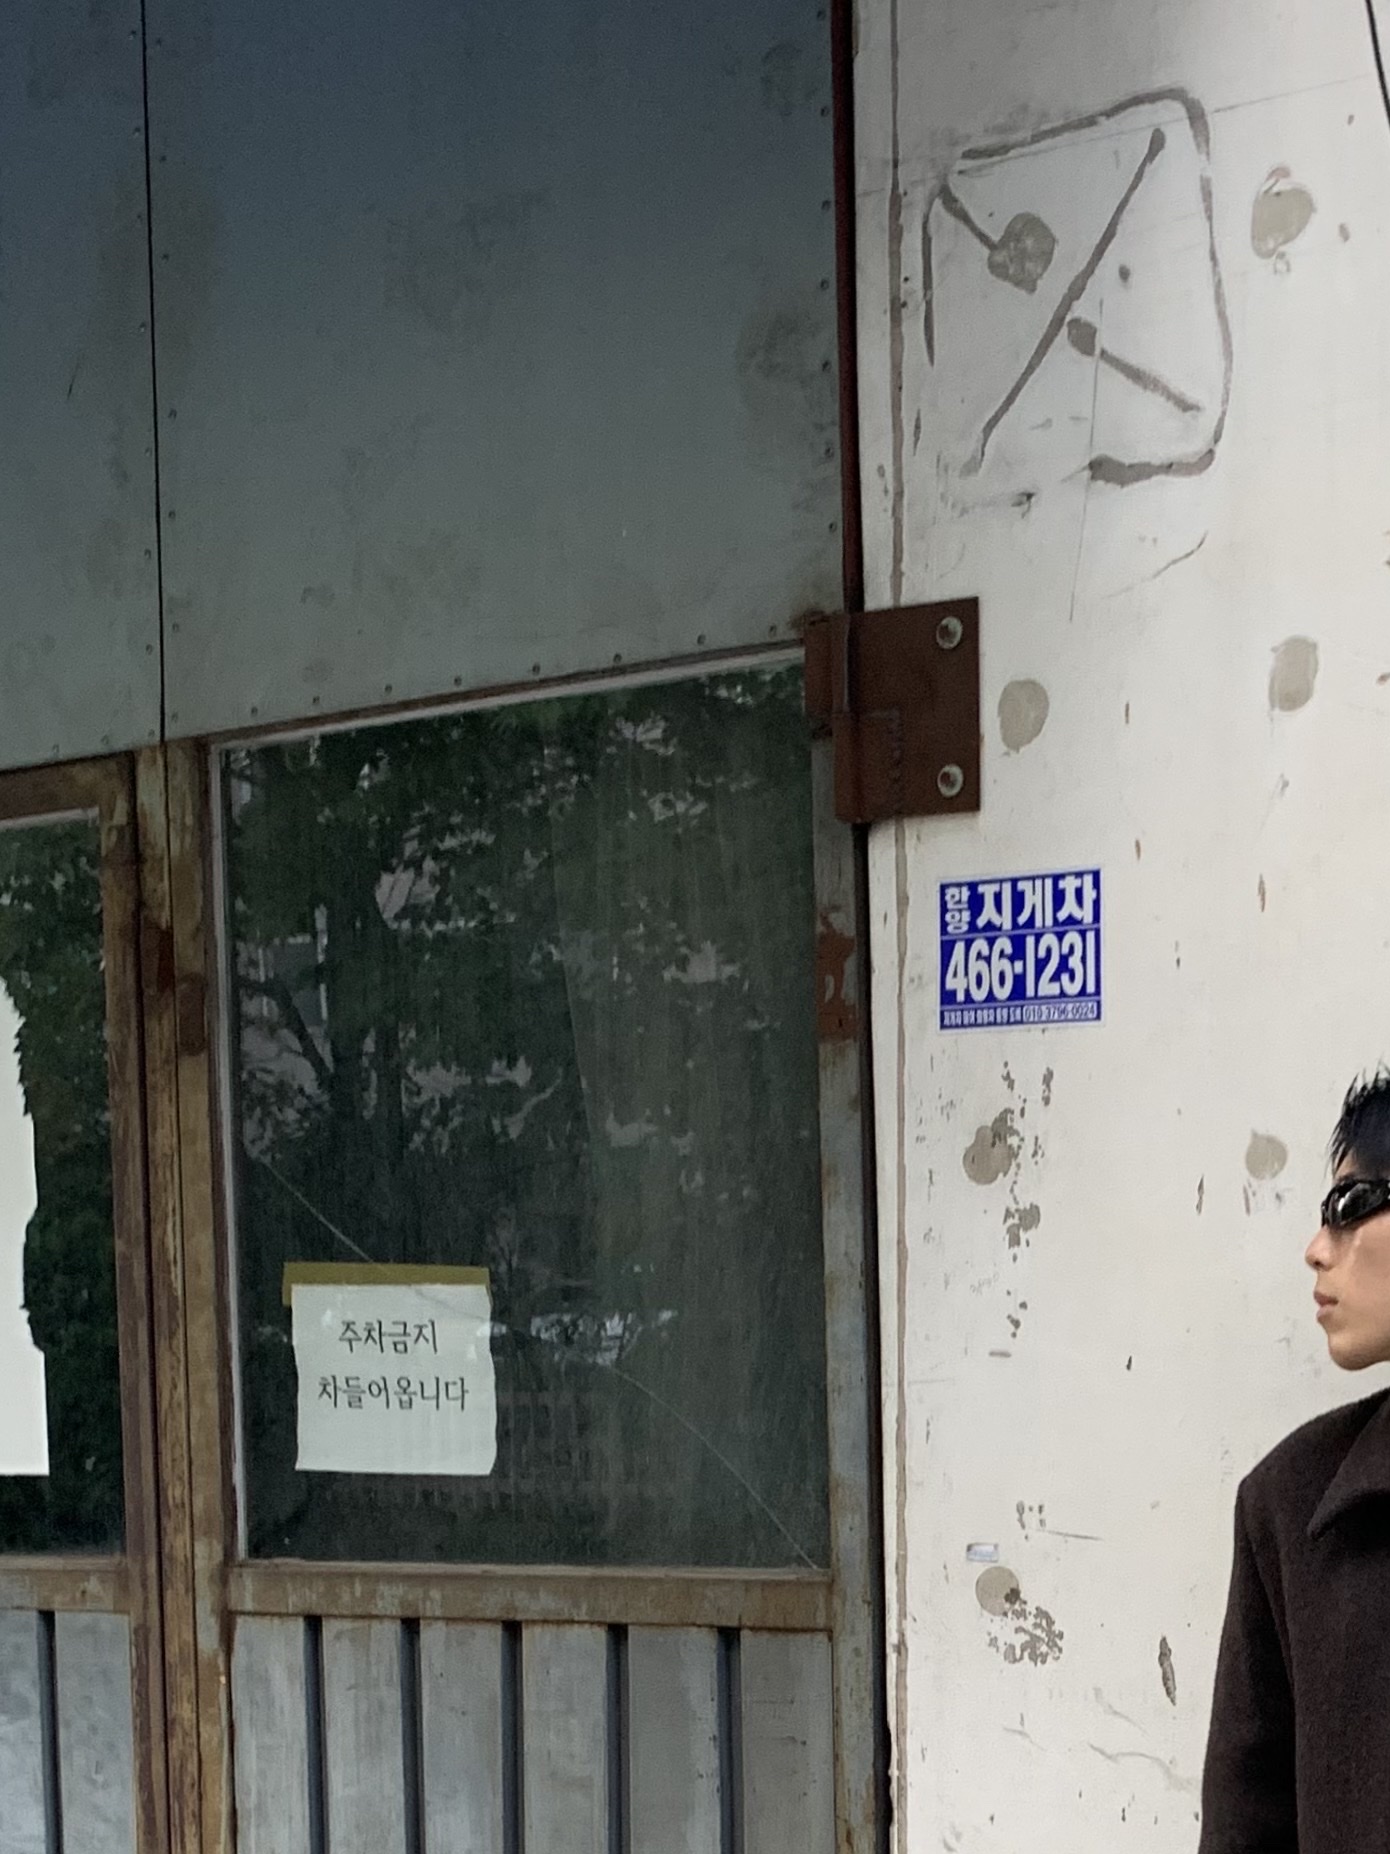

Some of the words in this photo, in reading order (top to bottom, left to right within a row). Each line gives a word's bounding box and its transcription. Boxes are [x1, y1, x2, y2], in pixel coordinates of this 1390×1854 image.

[976, 873, 1097, 932] 지게차
[945, 930, 1096, 1003] 466-1231
[339, 1318, 438, 1355] 주차금지
